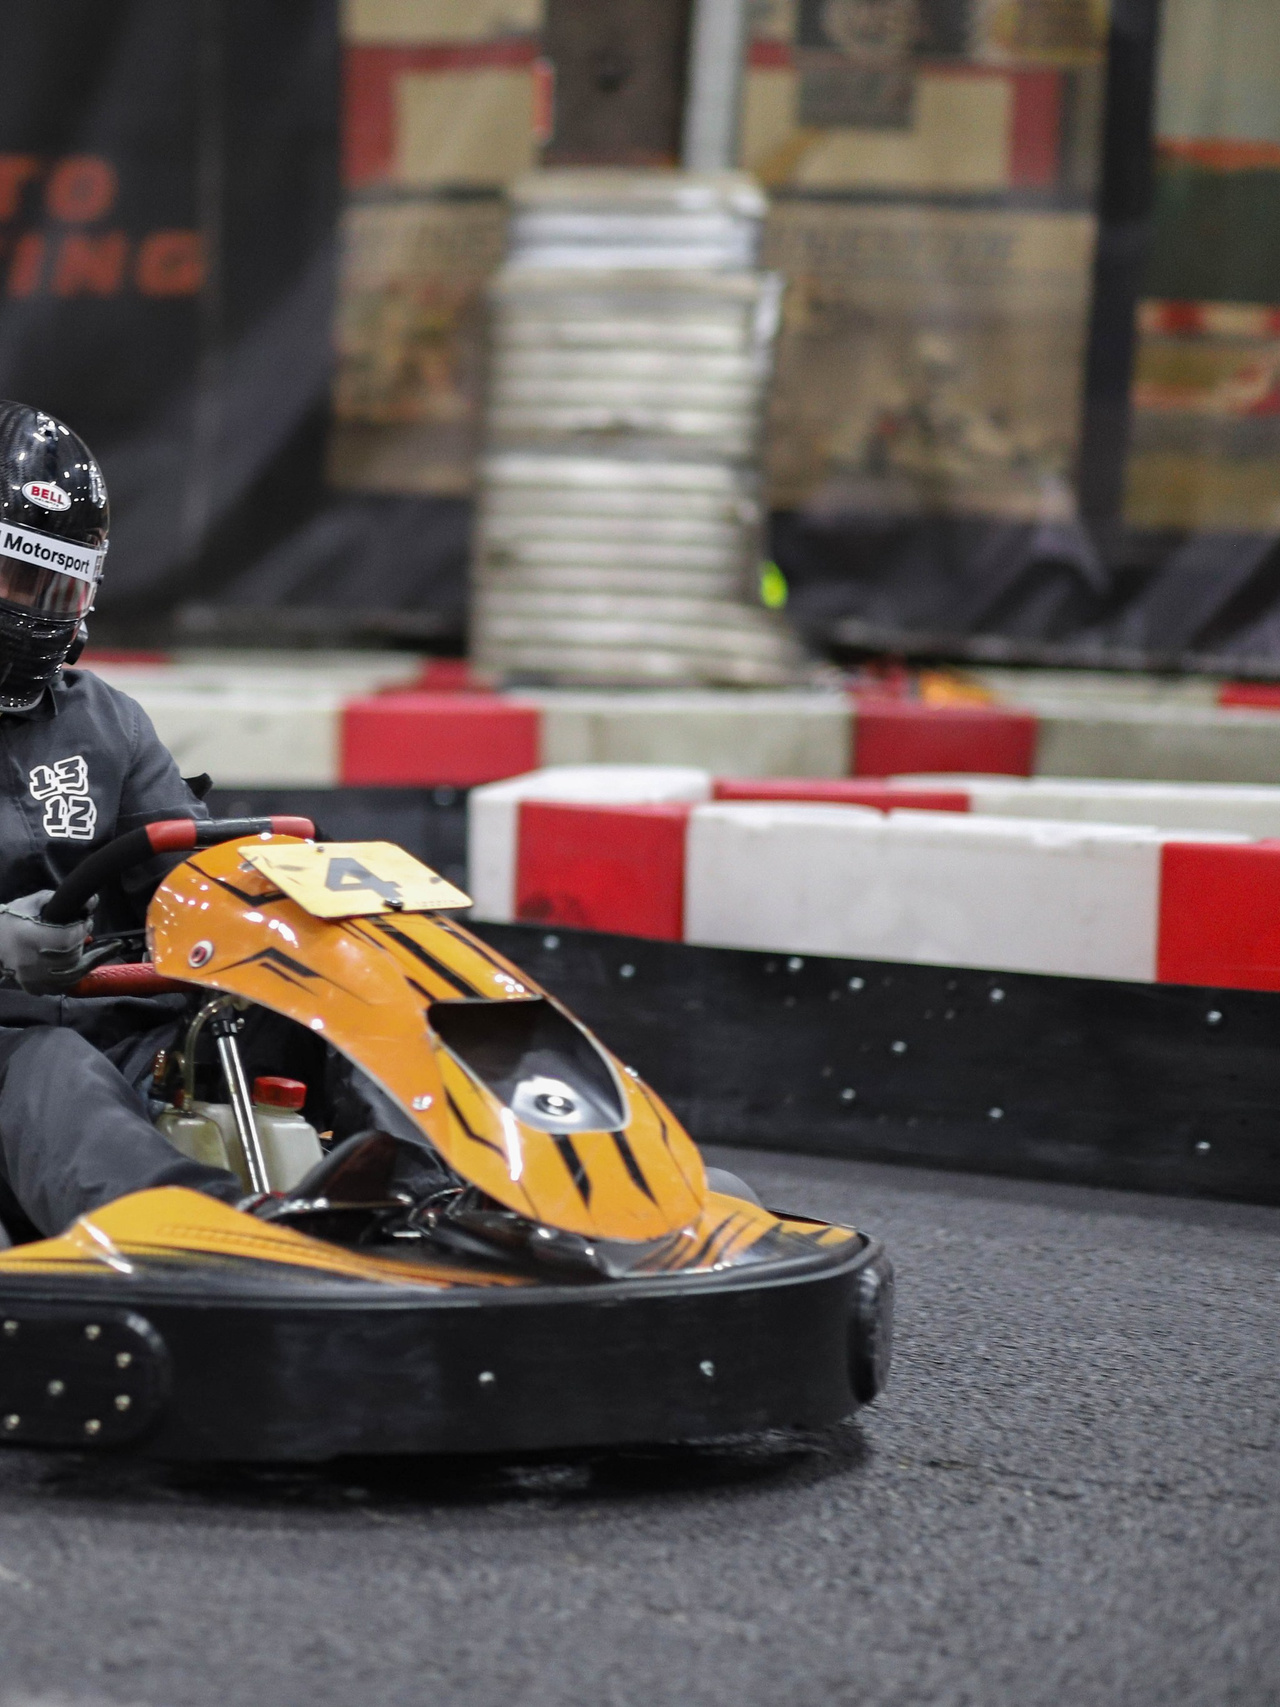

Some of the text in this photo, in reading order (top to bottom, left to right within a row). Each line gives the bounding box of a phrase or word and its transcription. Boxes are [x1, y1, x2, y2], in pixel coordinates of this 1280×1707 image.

[31, 485, 65, 506] BELL
[3, 532, 90, 574] Motorsport
[29, 755, 89, 800] 13
[43, 795, 97, 840] 12
[324, 857, 403, 899] 4
